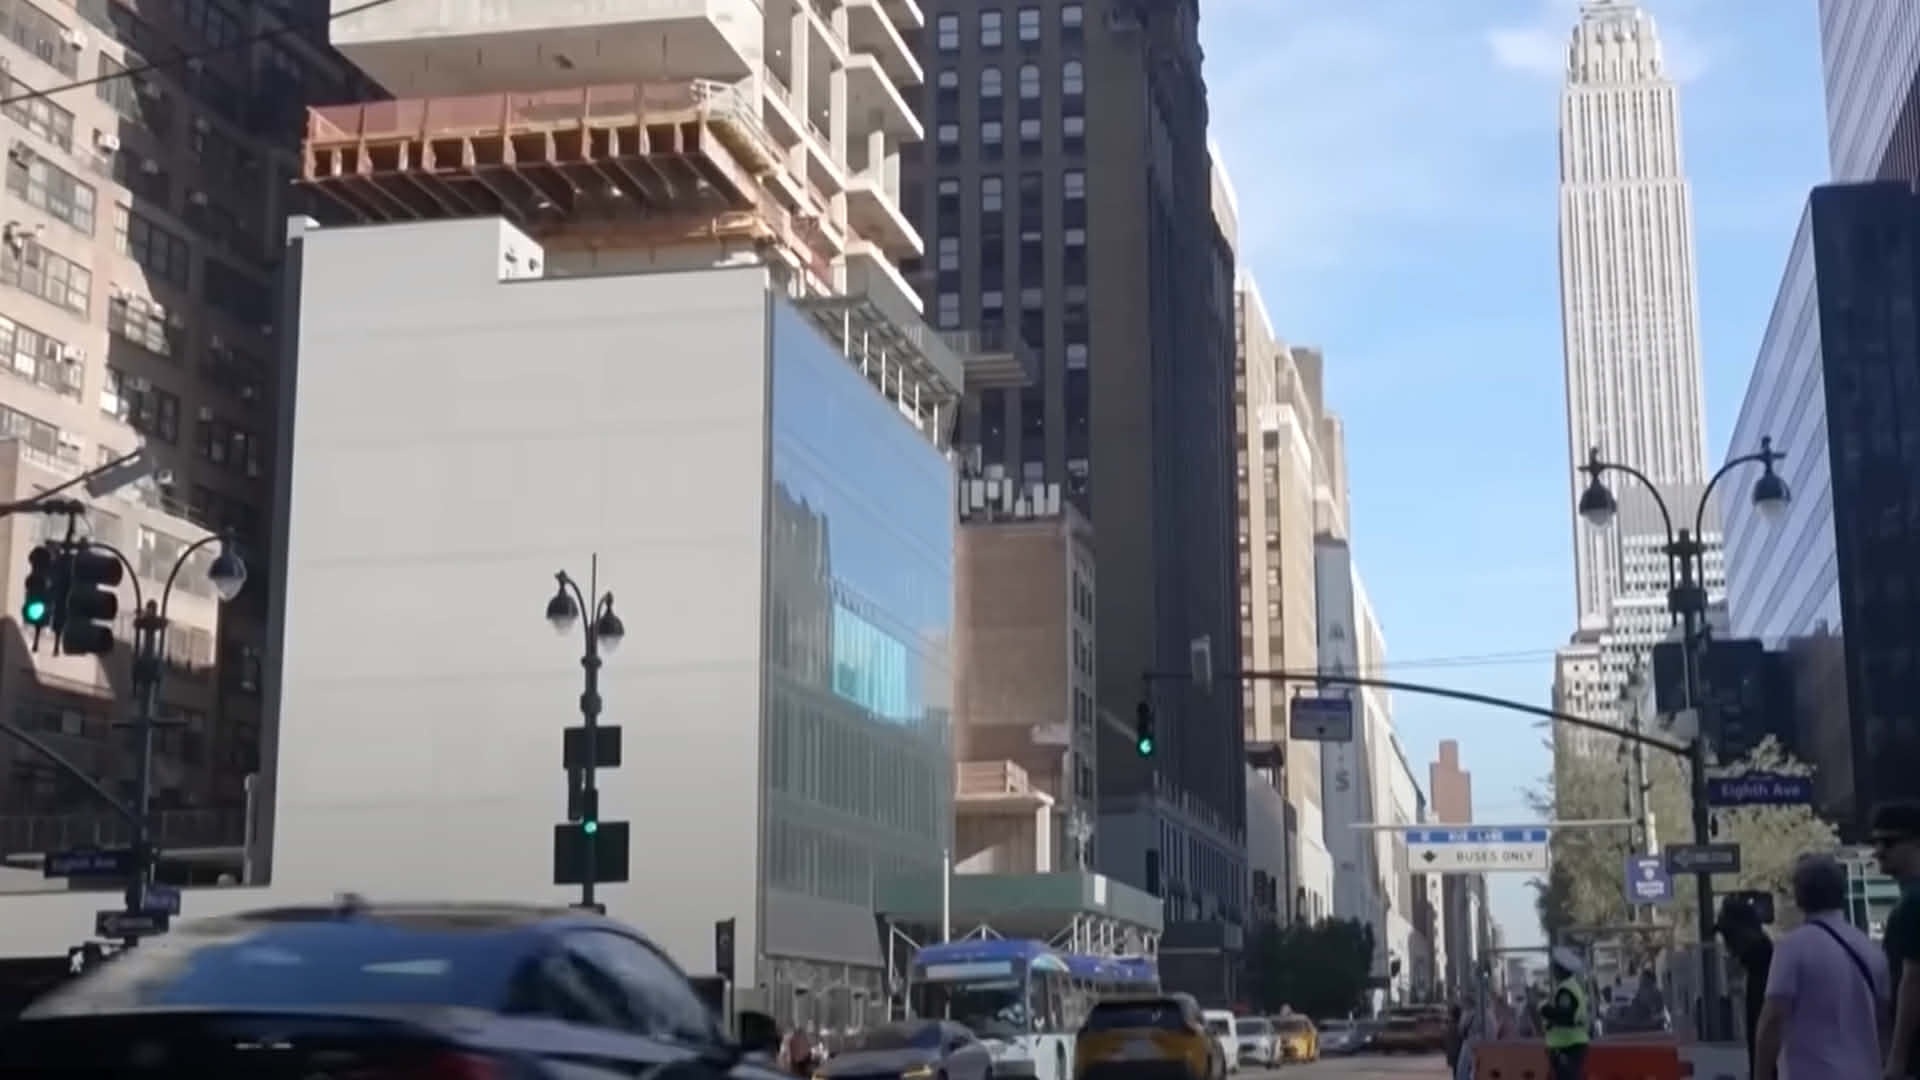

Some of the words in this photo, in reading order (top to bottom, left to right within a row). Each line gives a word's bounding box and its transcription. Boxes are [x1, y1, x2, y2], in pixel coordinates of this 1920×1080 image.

[1721, 783, 1769, 800] Eighth
[1773, 783, 1801, 797] Ave
[1456, 851, 1497, 863] BUSES
[1502, 851, 1534, 863] ONLY
